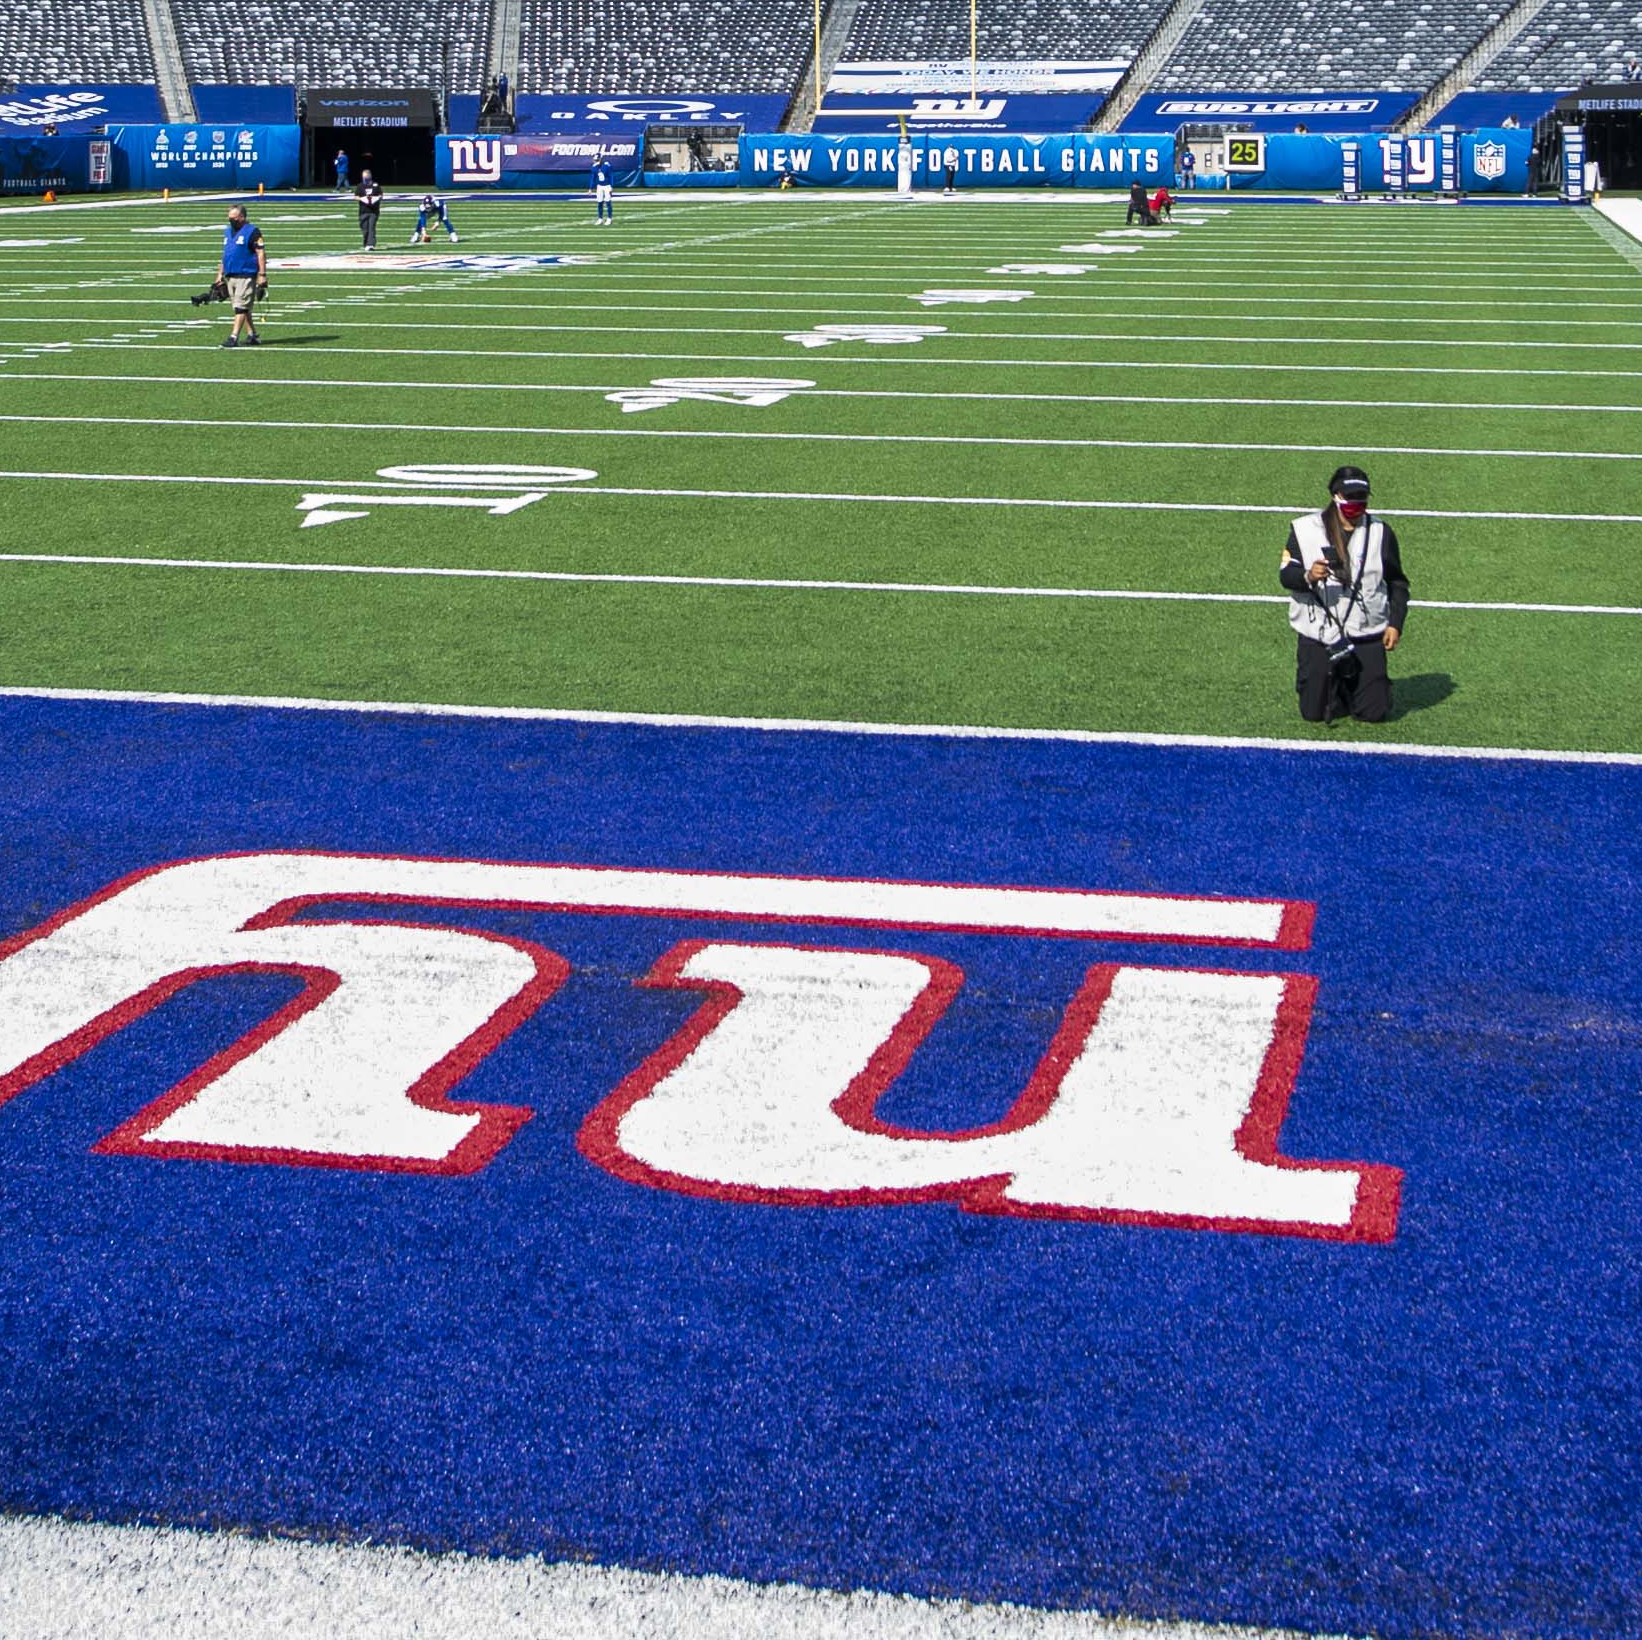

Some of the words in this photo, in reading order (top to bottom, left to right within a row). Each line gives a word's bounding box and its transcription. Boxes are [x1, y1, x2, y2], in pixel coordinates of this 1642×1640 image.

[319, 98, 410, 107] verizon
[1169, 100, 1254, 113] BUD
[1256, 100, 1368, 113] LIGHT
[1578, 100, 1616, 110] METLIFE
[1, 107, 109, 126] Stadium
[333, 117, 369, 127] METLIFE
[370, 117, 408, 127] STADIUM
[551, 112, 744, 120] OAKLEY
[150, 152, 189, 161] WORLD
[194, 152, 258, 161] CHAMPIONS
[1231, 143, 1257, 161] 25
[449, 139, 501, 181] ny
[754, 148, 812, 172] NEW
[829, 148, 898, 172] YORK
[1061, 148, 1159, 173] GIANTS
[1477, 157, 1502, 173] NFL
